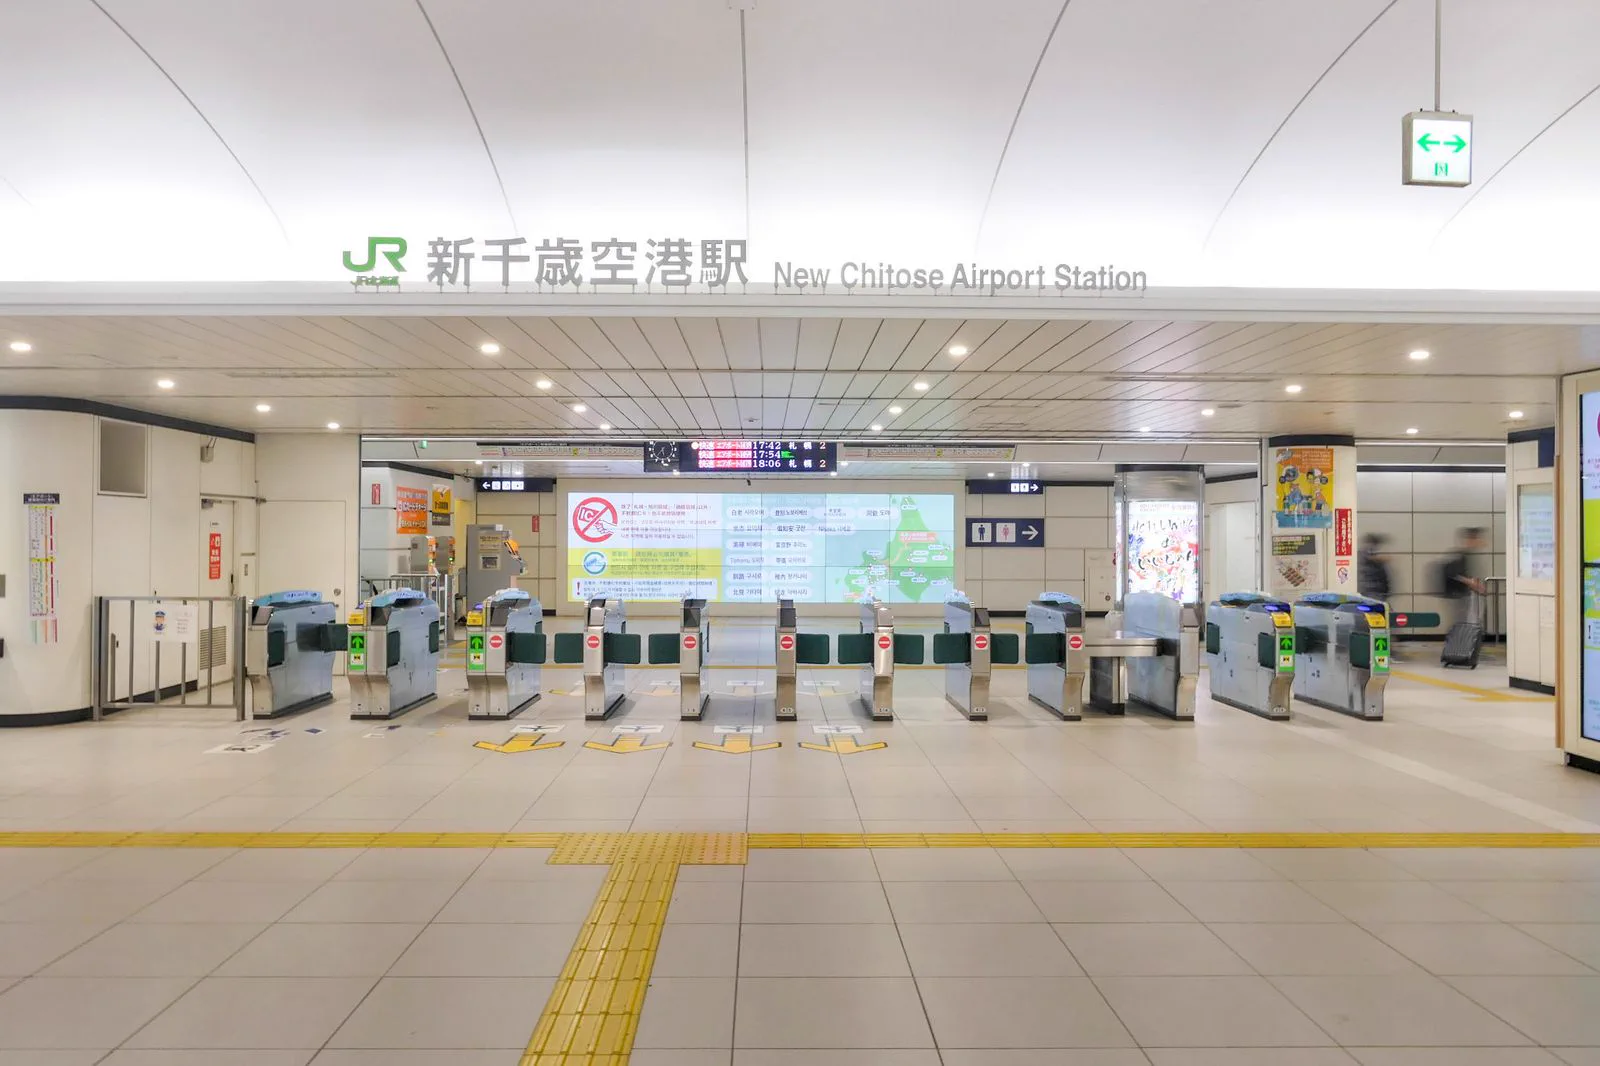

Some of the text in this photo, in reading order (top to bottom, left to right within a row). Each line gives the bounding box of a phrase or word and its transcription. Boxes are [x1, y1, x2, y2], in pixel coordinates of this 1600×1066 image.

[343, 237, 407, 272] JR
[427, 237, 748, 287] 新千歳空港駅
[774, 262, 1147, 295] New Chitose Airport Station
[753, 441, 781, 450] 17:42
[819, 441, 826, 450] 2
[753, 450, 781, 459] 17:54
[753, 459, 781, 468] 18:06
[819, 459, 826, 468] 2
[580, 508, 594, 521] IC
